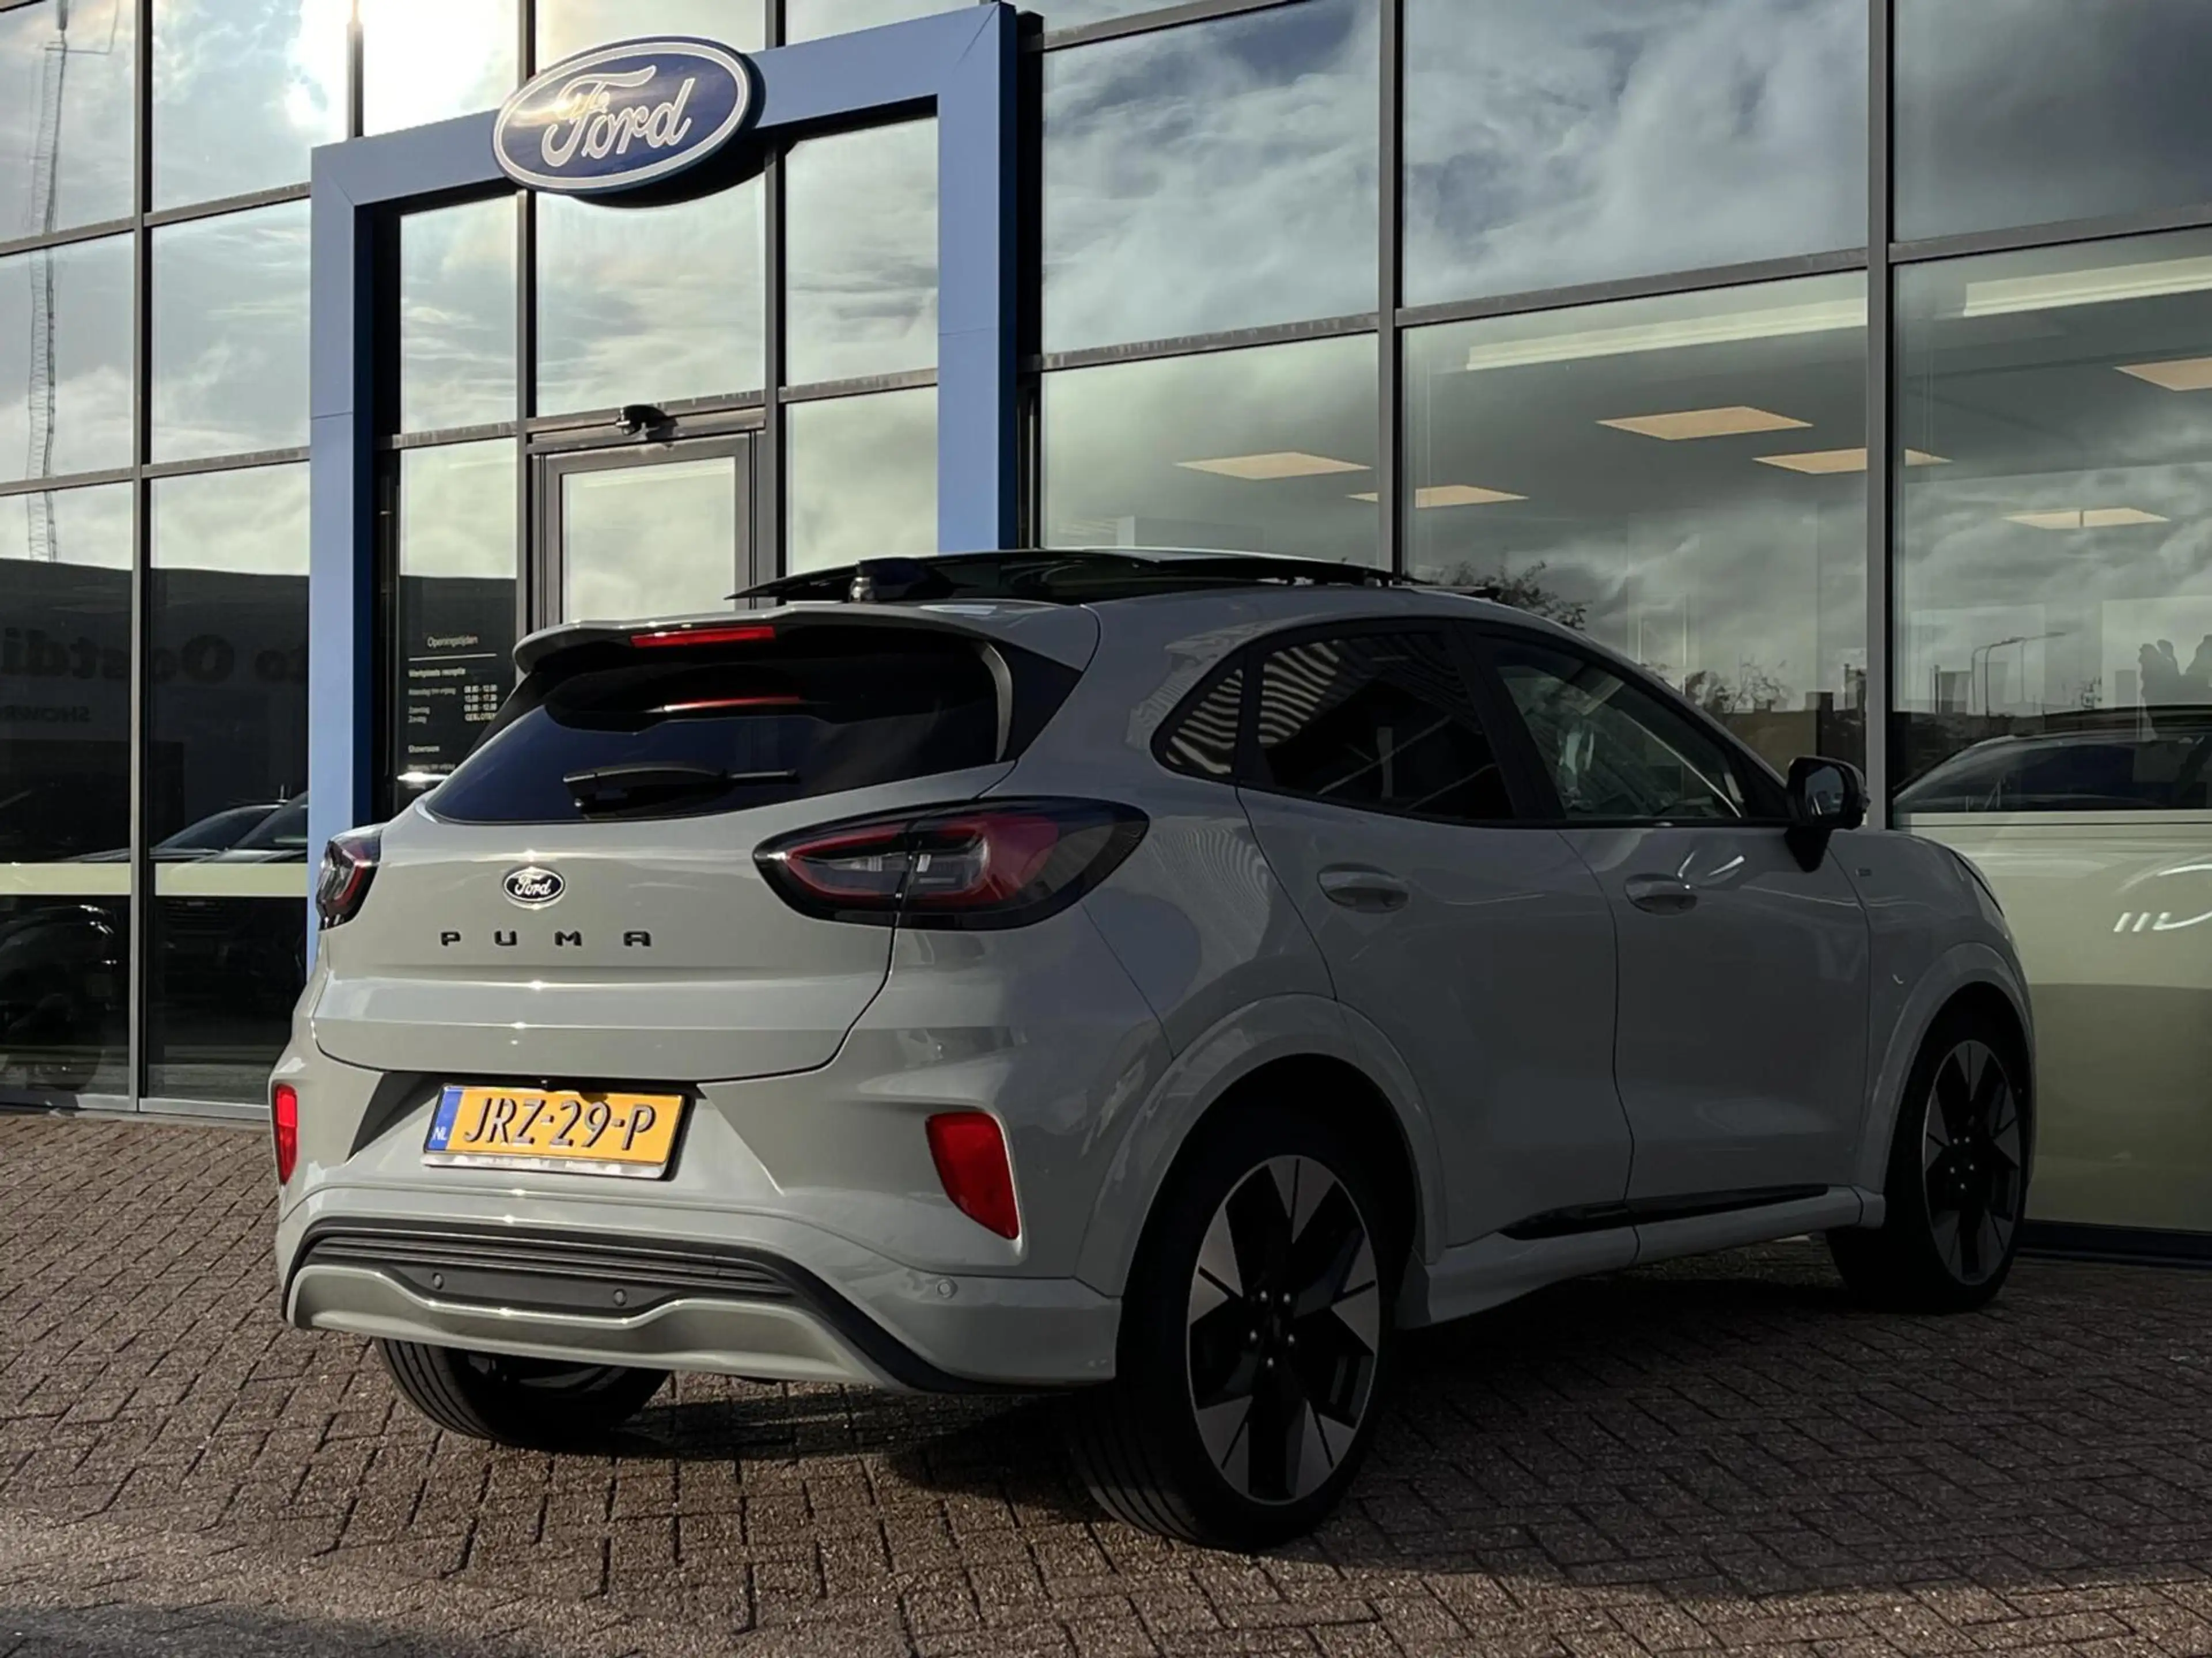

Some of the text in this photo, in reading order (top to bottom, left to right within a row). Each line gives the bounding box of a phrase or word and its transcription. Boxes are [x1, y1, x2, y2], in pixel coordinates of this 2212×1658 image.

[541, 65, 695, 167] Ford
[514, 874, 551, 896] Ford
[441, 930, 652, 947] PUMA
[432, 1126, 448, 1141] NL
[463, 1097, 657, 1151] JRZ-29-P
